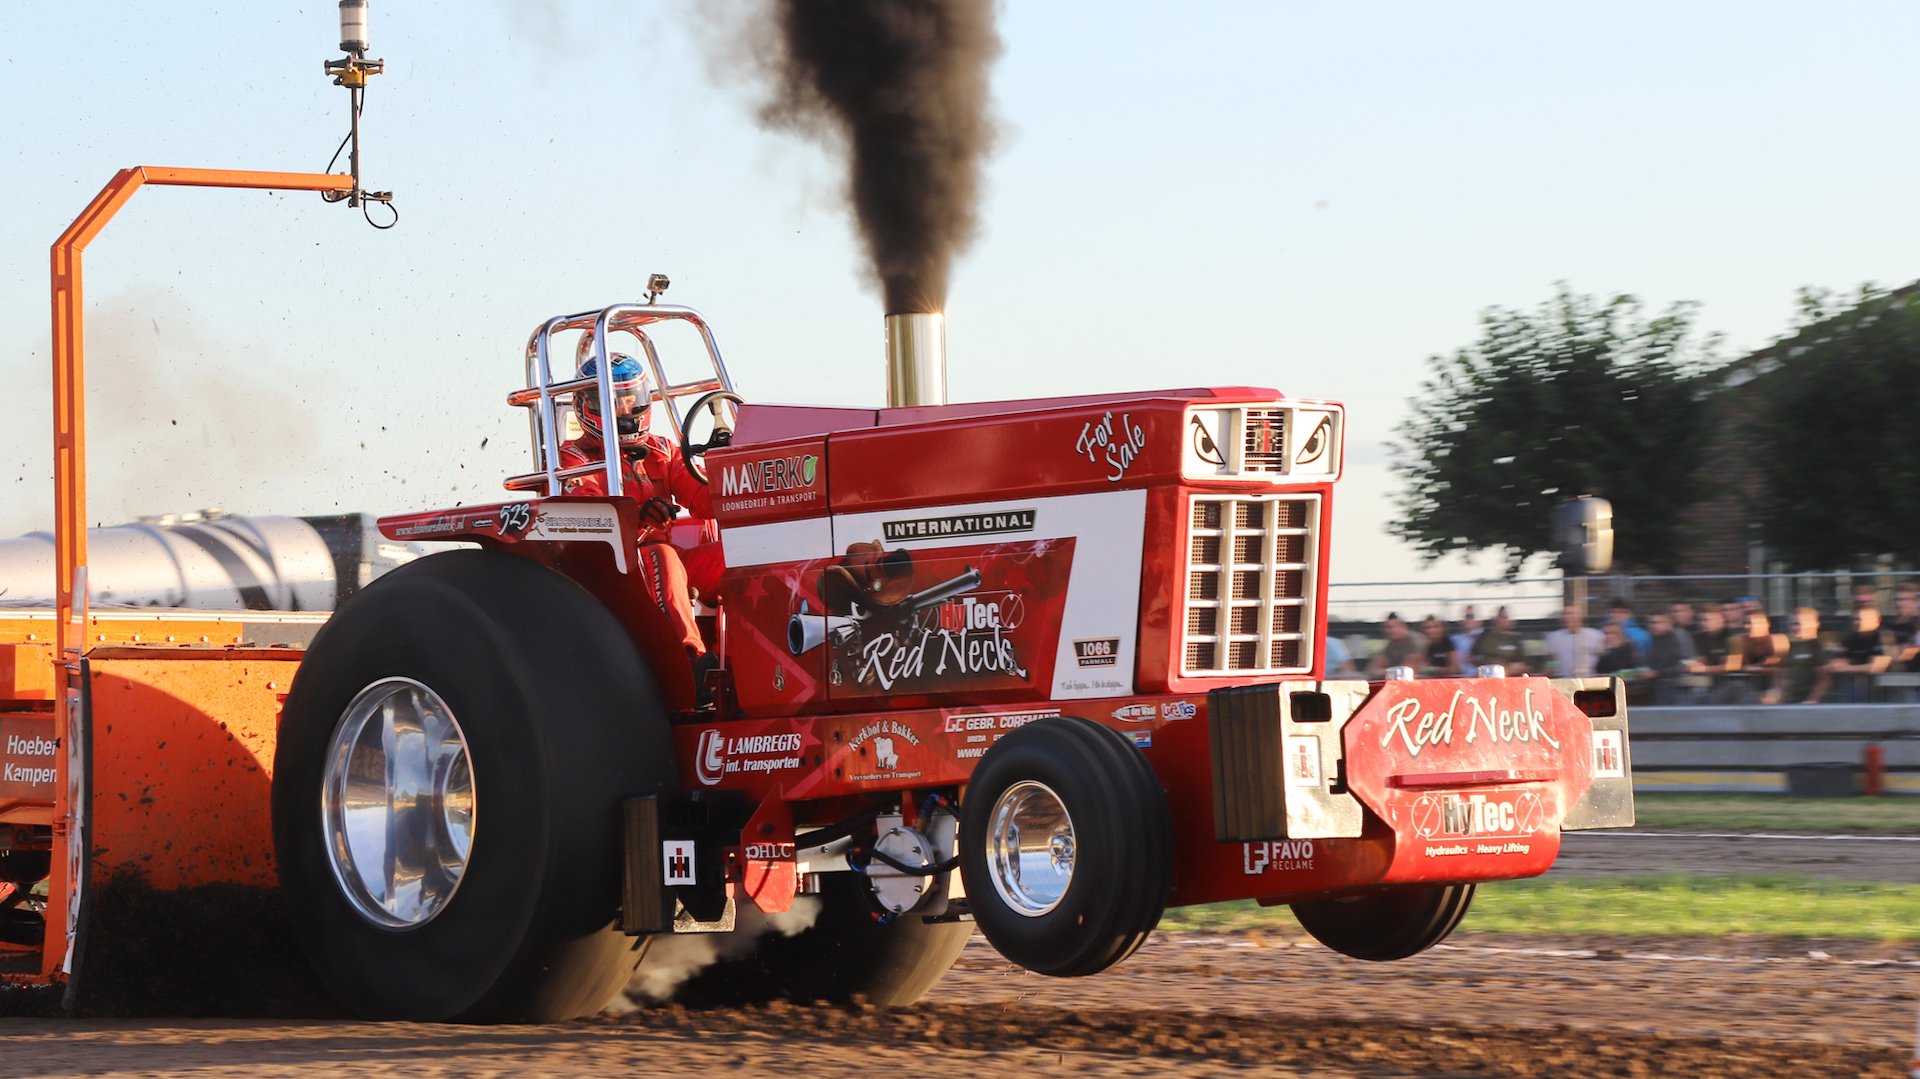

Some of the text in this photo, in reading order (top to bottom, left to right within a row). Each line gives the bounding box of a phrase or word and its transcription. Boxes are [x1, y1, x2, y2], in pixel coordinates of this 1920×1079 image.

[1075, 410, 1113, 462] For
[1106, 413, 1146, 481] Sale
[721, 454, 818, 497] MAVERKO
[721, 491, 817, 511] LOONBEDRIJF & TRANSPORT
[498, 503, 530, 536] 523
[886, 513, 1032, 538] INTERNATIONAL
[857, 622, 1027, 691] Red Neck
[1082, 641, 1111, 656] 1066
[966, 718, 997, 731] GEBR.
[1381, 688, 1560, 756] Red Neck
[727, 733, 802, 755] LAMBREGTS
[848, 720, 920, 752] Kerkhof & Bakker
[725, 756, 800, 775] int. transporten
[1442, 794, 1515, 836] HyTec
[1272, 841, 1314, 860] FAVO
[1425, 845, 1468, 858] Hydraulics
[1476, 844, 1503, 855] Heavy
[1503, 843, 1530, 855] Lifting
[1272, 860, 1315, 871] RECLAME
